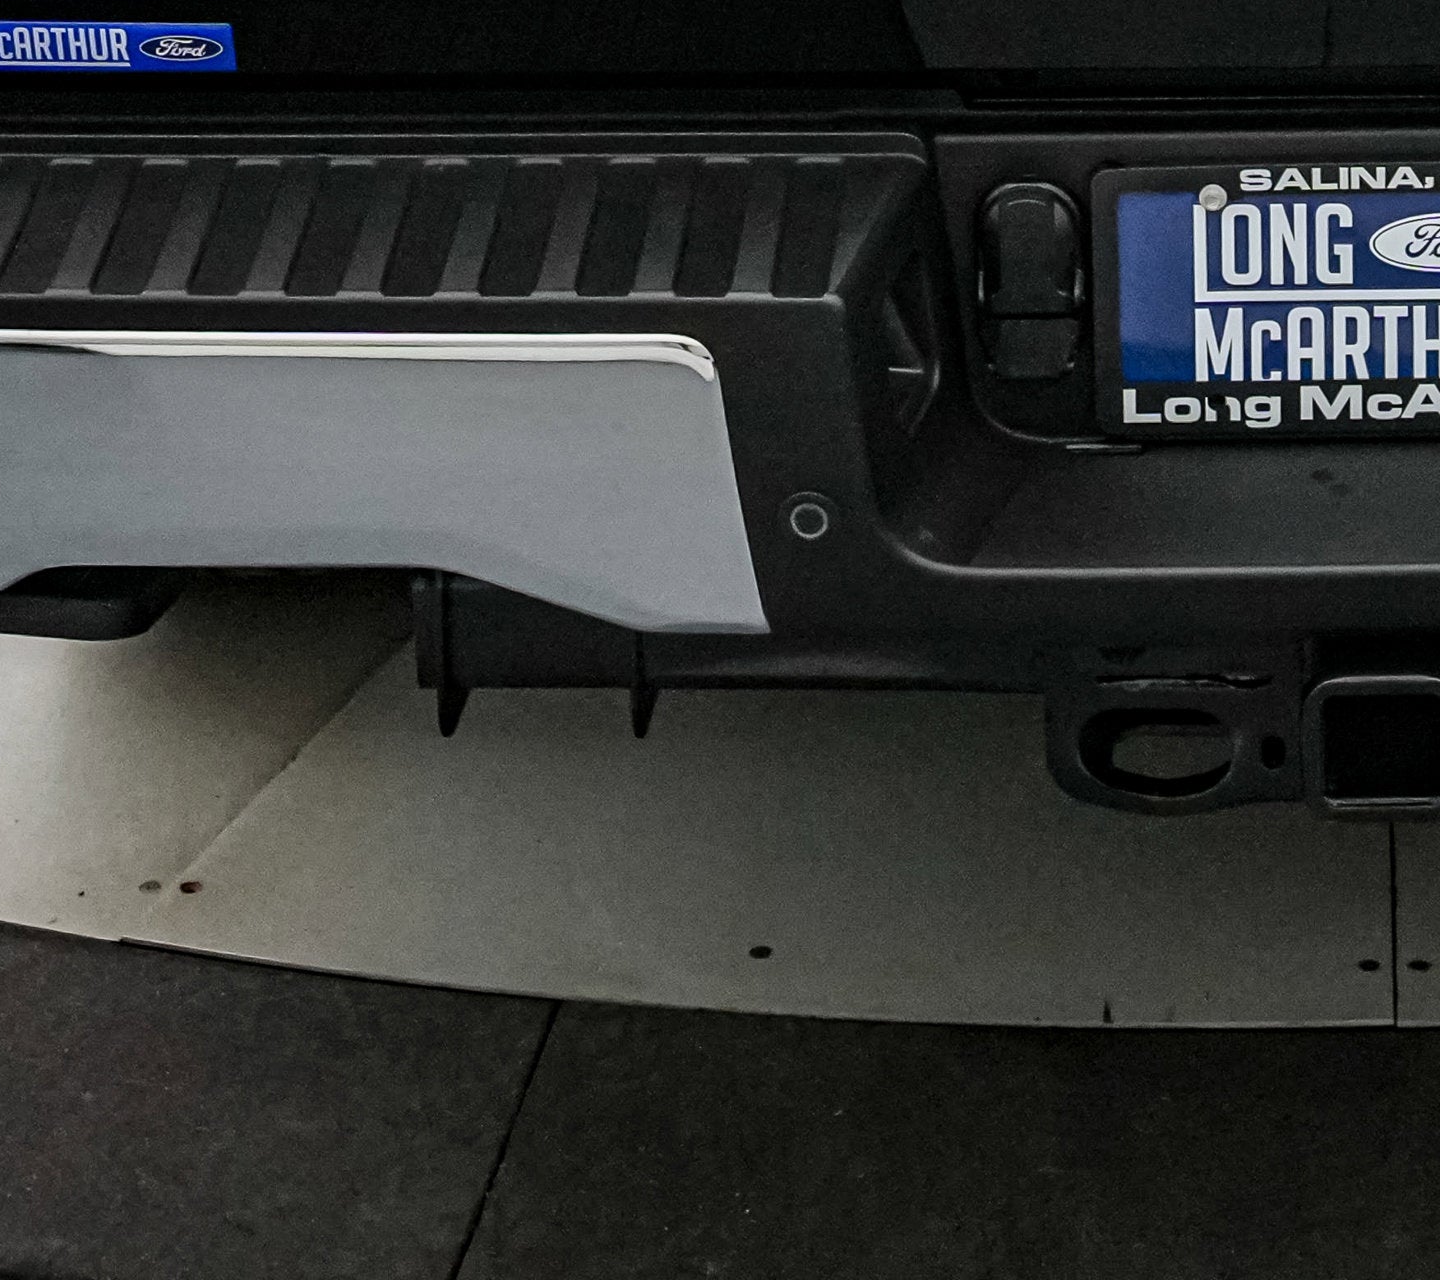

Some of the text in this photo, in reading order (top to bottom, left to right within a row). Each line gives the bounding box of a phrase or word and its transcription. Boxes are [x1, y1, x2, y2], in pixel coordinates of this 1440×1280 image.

[155, 38, 206, 57] Ford
[1239, 166, 1435, 192] SALINA,
[1193, 202, 1354, 303] LONG
[1123, 389, 1282, 428] Long
